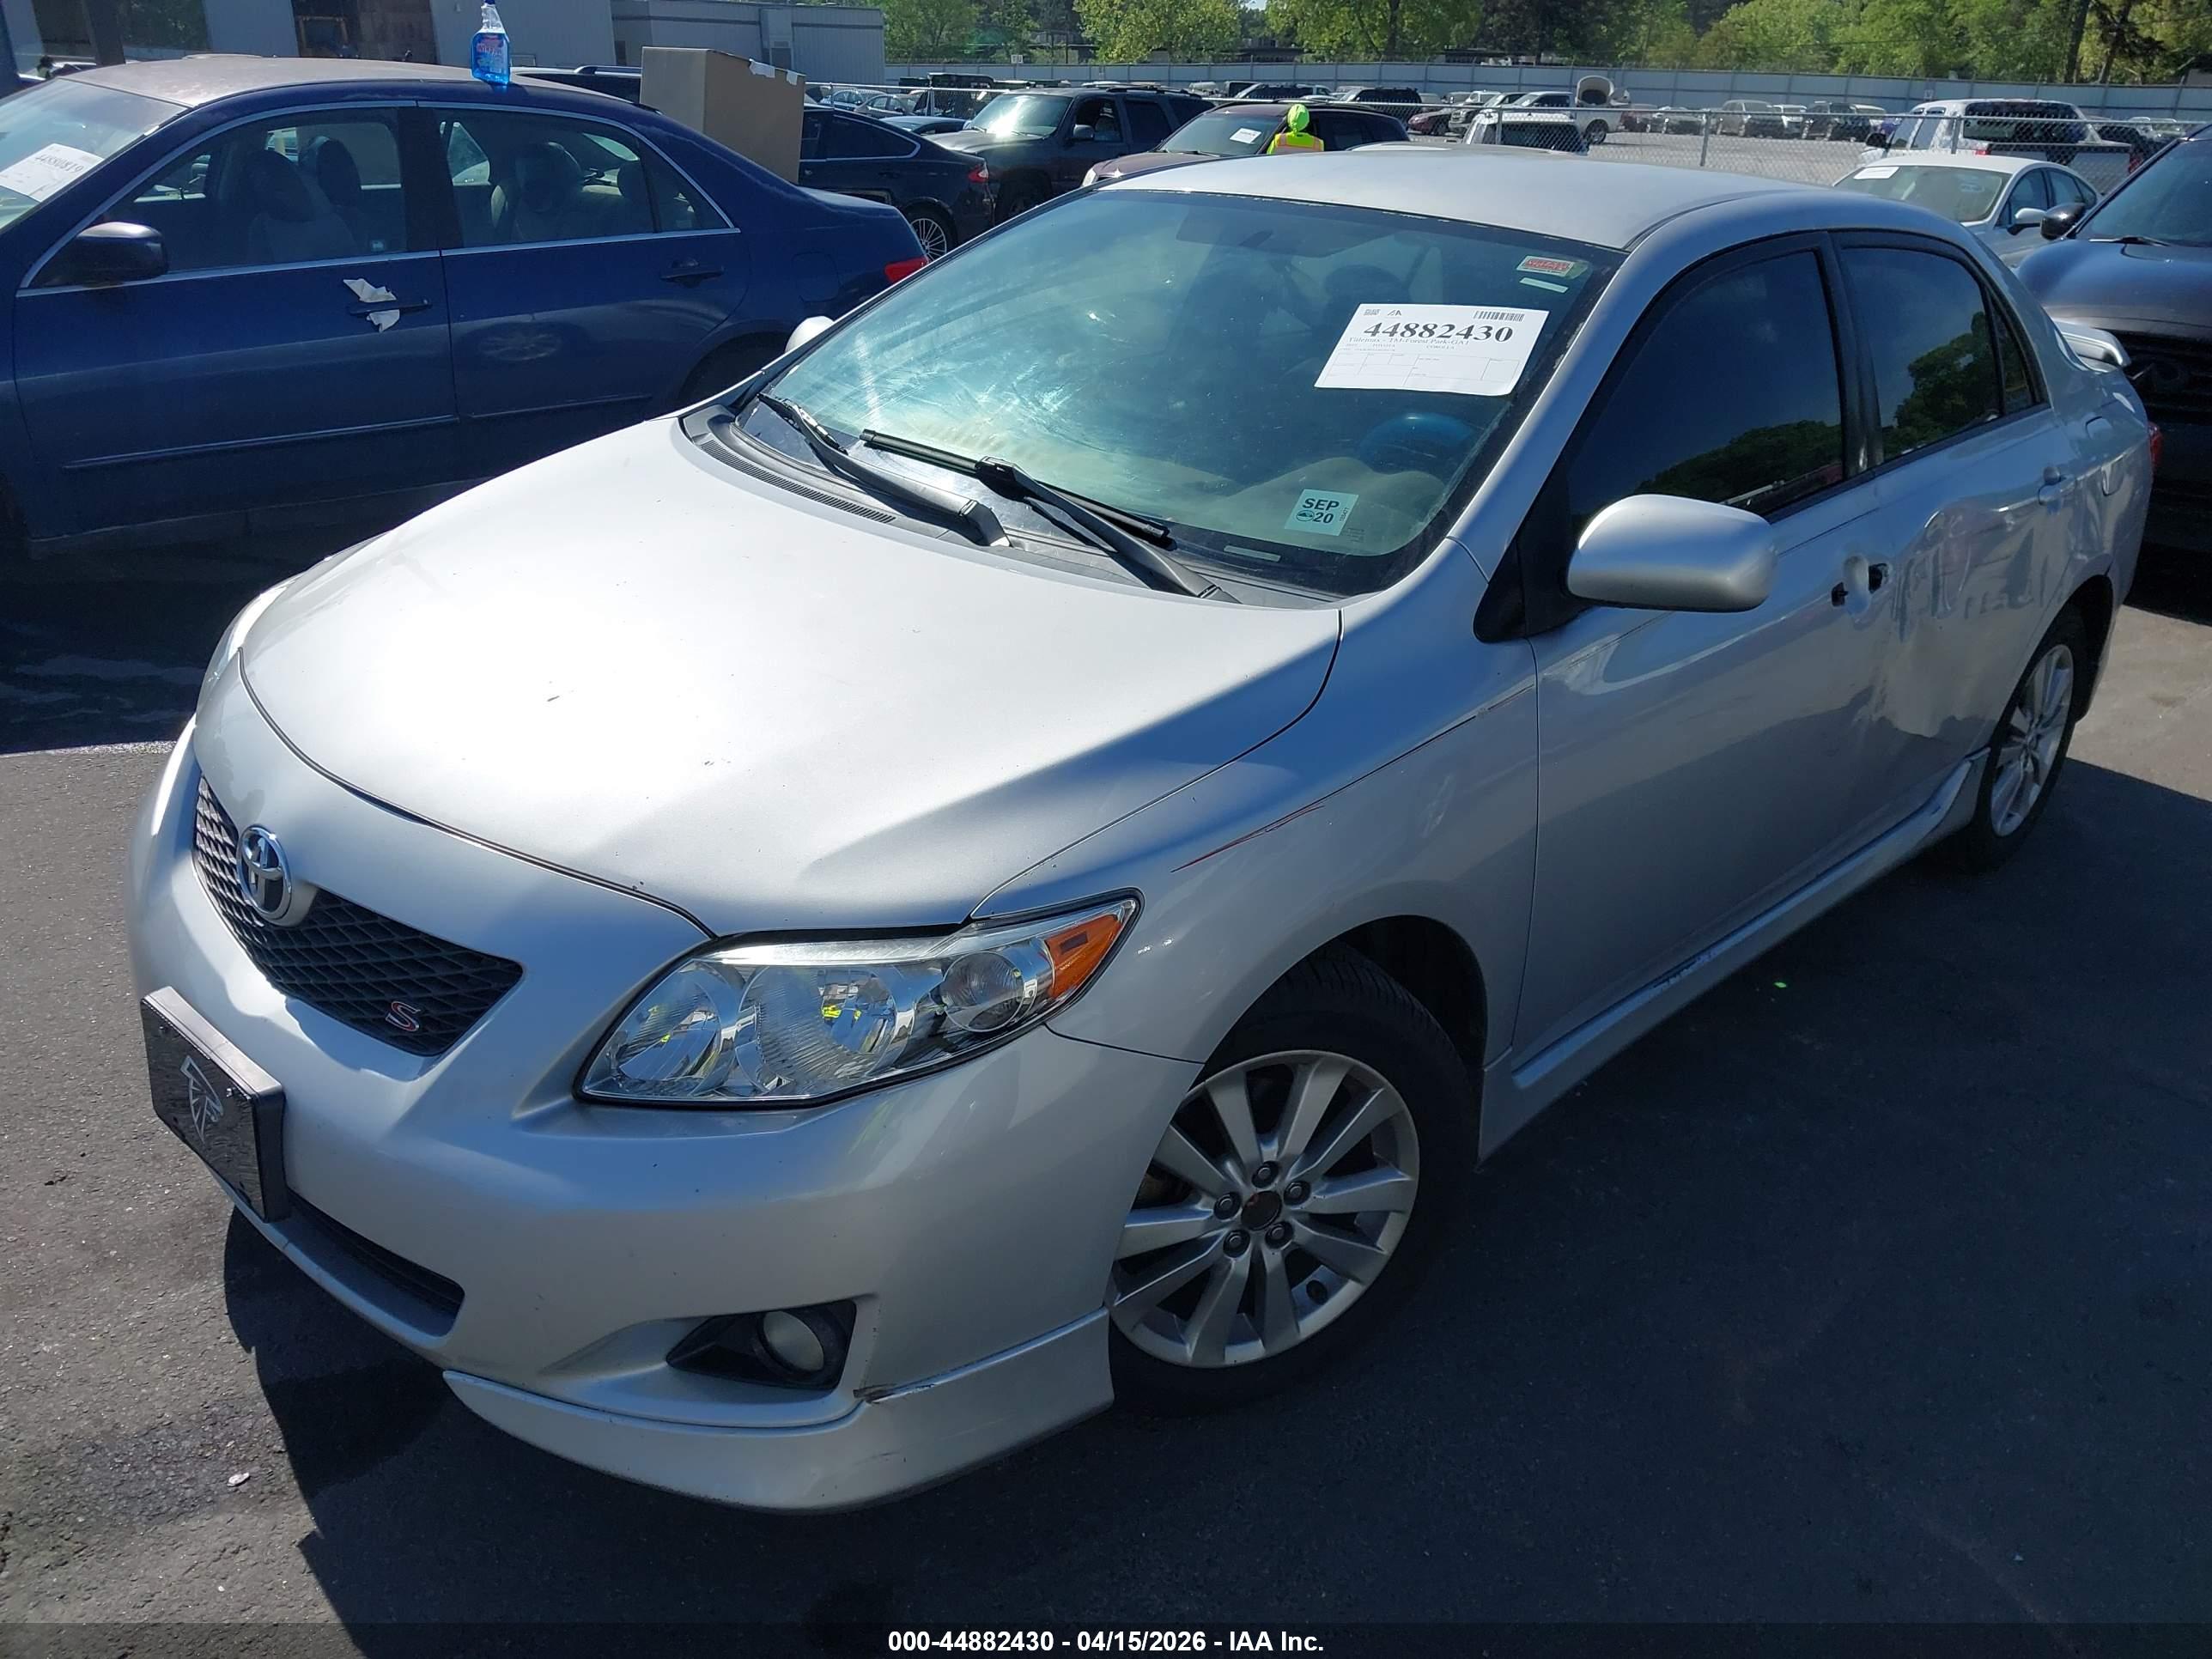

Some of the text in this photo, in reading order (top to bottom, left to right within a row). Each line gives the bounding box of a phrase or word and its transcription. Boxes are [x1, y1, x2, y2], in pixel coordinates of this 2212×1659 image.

[1364, 322, 1513, 342] 44882430
[1302, 498, 1340, 511] SEP
[1312, 512, 1334, 524] 20
[386, 1000, 421, 1032] S
